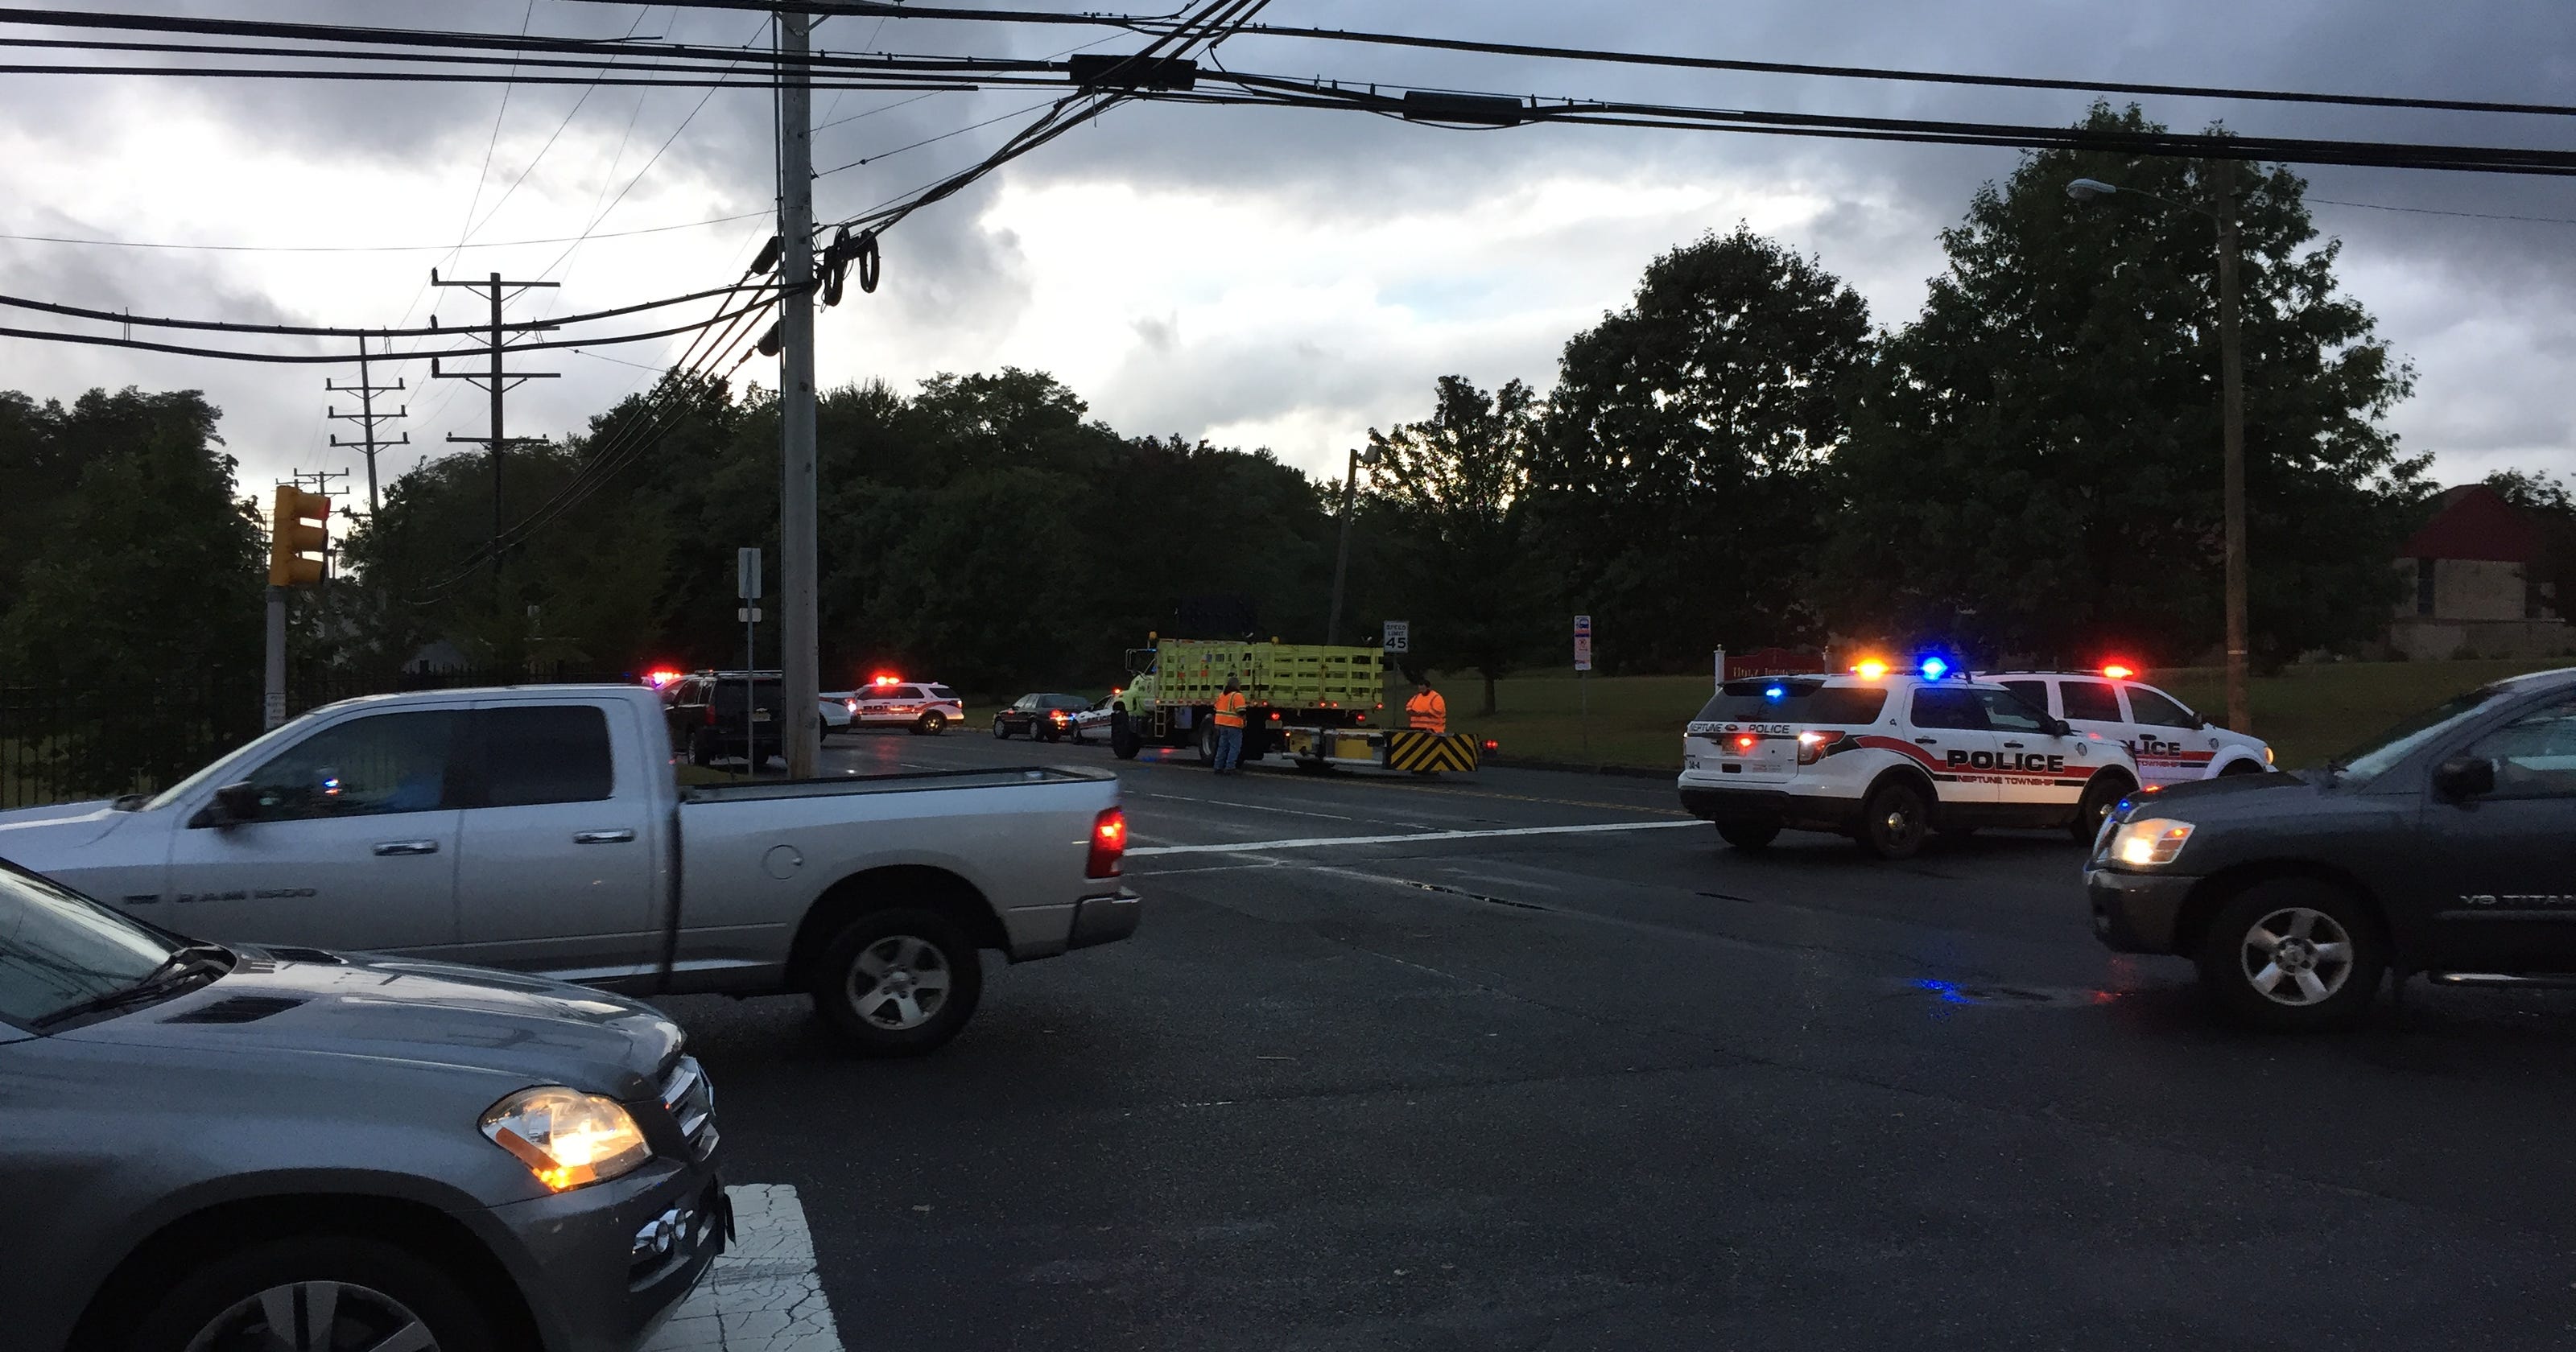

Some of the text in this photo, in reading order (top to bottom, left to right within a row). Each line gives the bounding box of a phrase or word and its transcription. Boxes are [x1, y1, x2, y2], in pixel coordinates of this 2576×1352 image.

[1385, 637, 1406, 649] 45
[1748, 724, 1790, 734] POLICE
[2121, 740, 2181, 756] LICE
[1946, 749, 2065, 773] POLICE
[1957, 775, 2054, 786] NEPTUNE TOWNSHIP
[2459, 894, 2497, 905] V8
